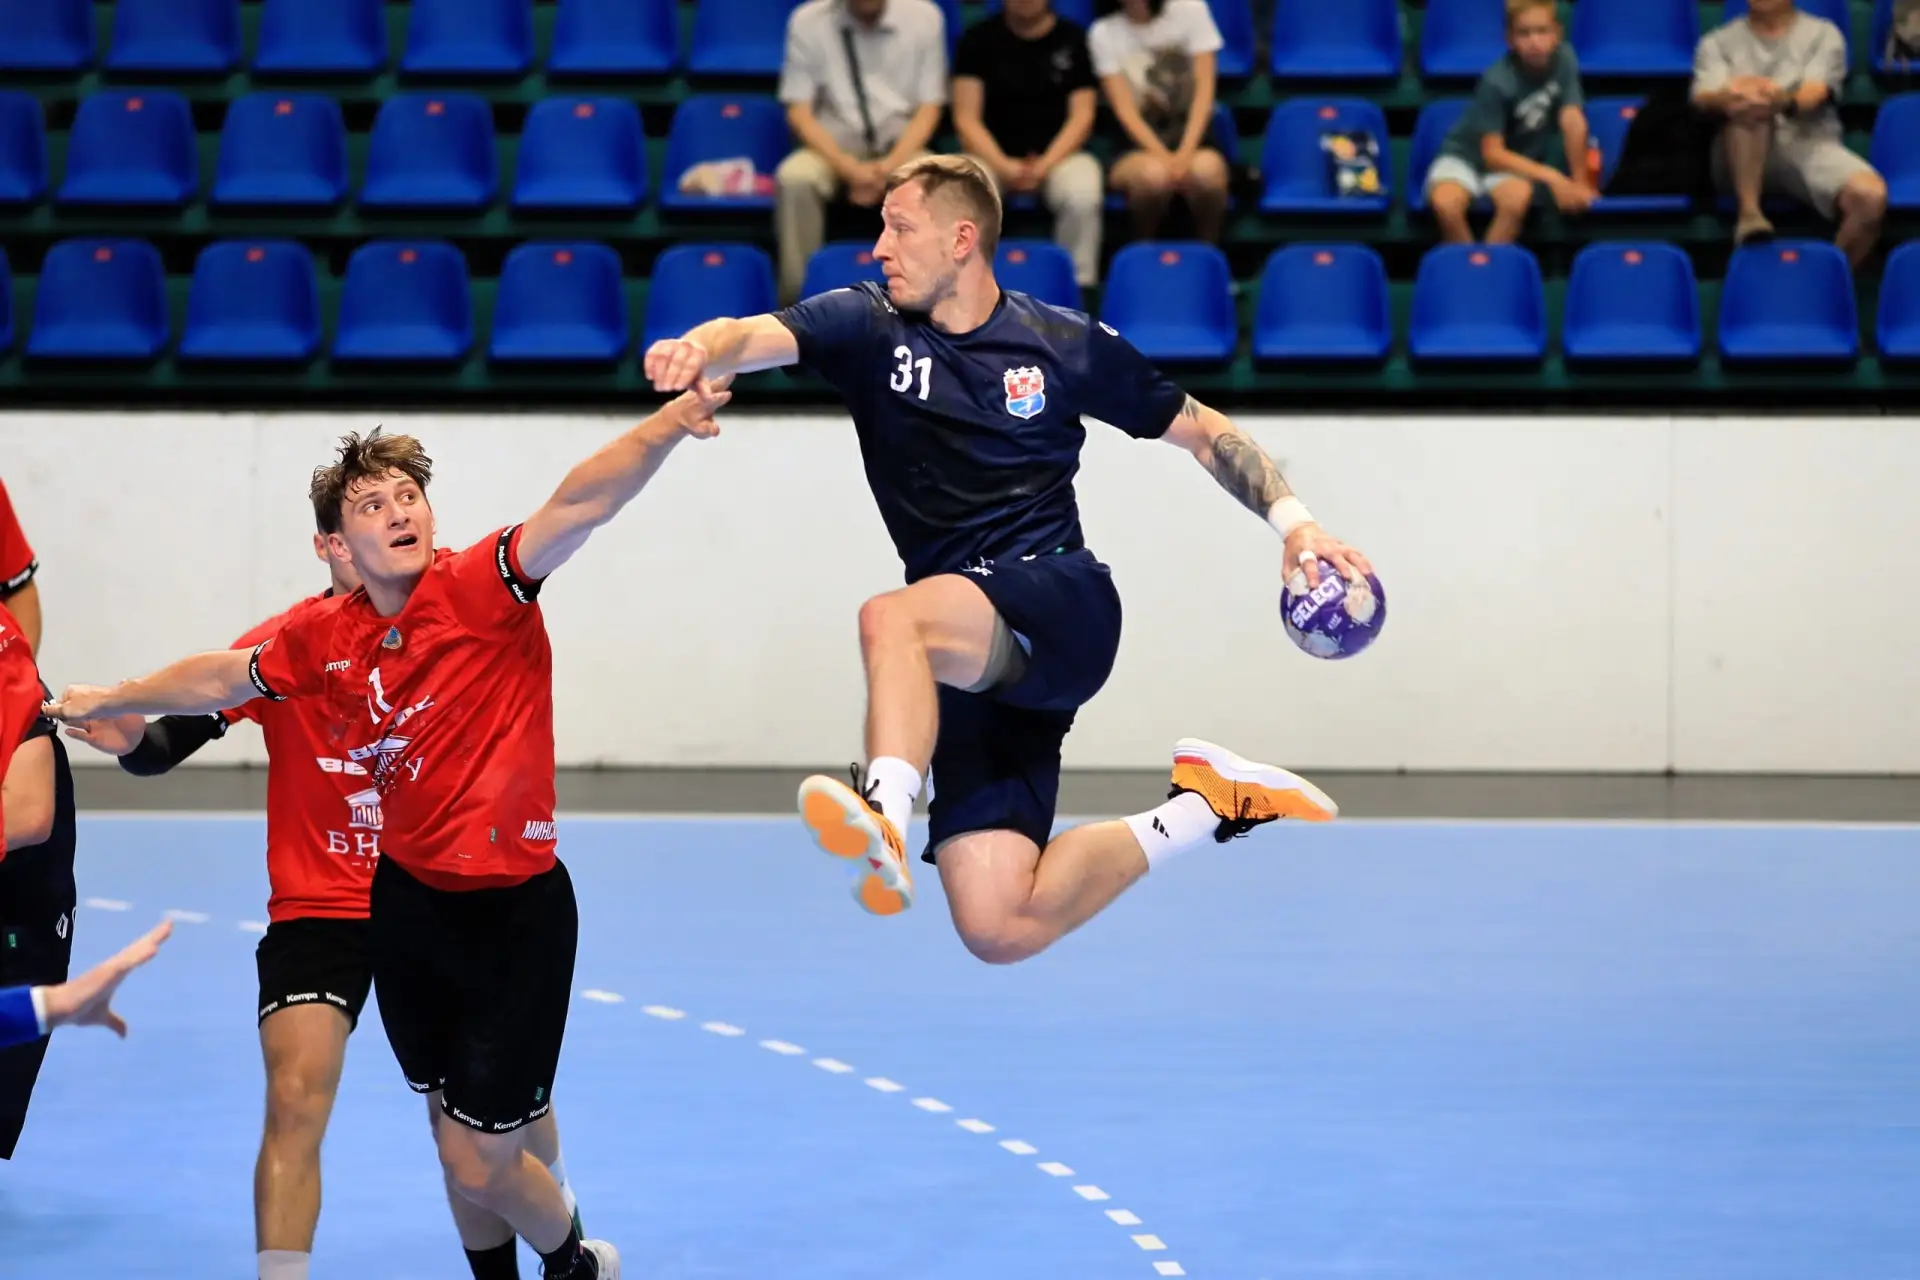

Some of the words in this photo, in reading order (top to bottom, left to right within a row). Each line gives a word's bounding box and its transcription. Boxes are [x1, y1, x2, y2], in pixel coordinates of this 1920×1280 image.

[890, 344, 932, 401] 31
[498, 545, 511, 578] Kempa
[1291, 575, 1345, 629] SELECT
[251, 662, 268, 692] Kempa
[286, 992, 318, 1003] Kempa
[453, 1107, 483, 1127] Kempa
[494, 1118, 522, 1130] Kempa
